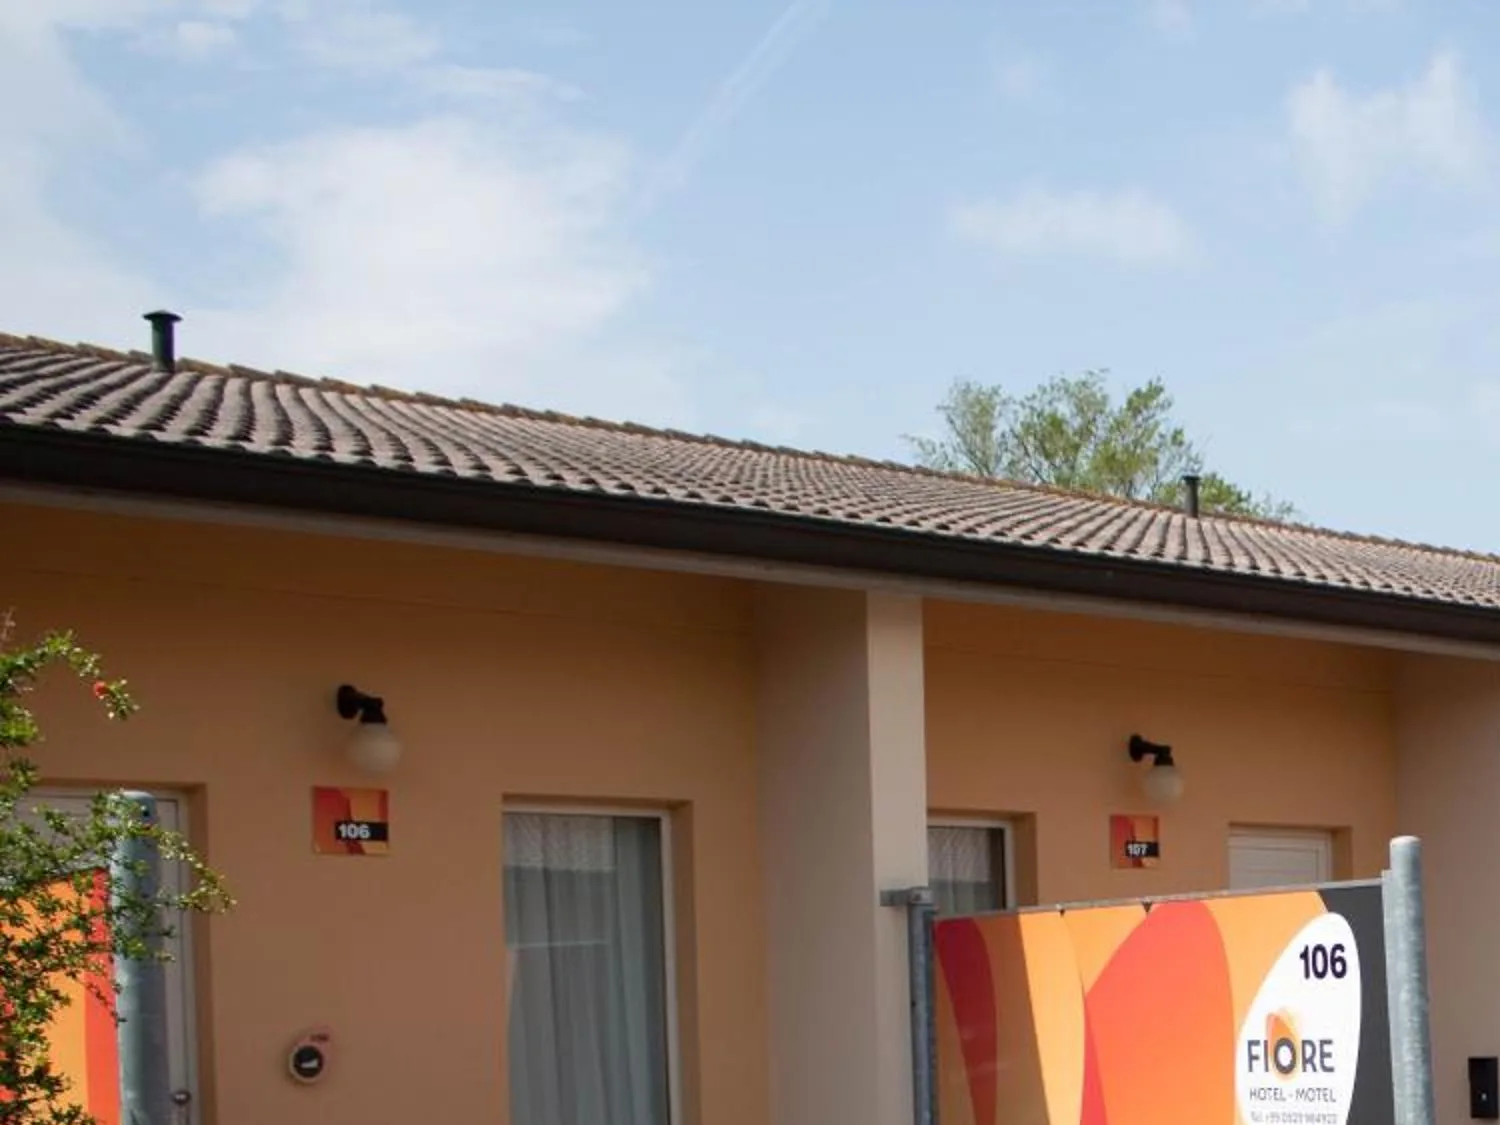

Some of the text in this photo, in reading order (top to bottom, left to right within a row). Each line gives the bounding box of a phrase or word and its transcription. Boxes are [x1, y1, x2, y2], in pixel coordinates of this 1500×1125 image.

[338, 823, 371, 839] 106
[1299, 943, 1347, 980] 106
[1247, 1037, 1335, 1075] FIORE
[1249, 1087, 1287, 1102] HOTEL
[1295, 1087, 1337, 1103] MOTEL
